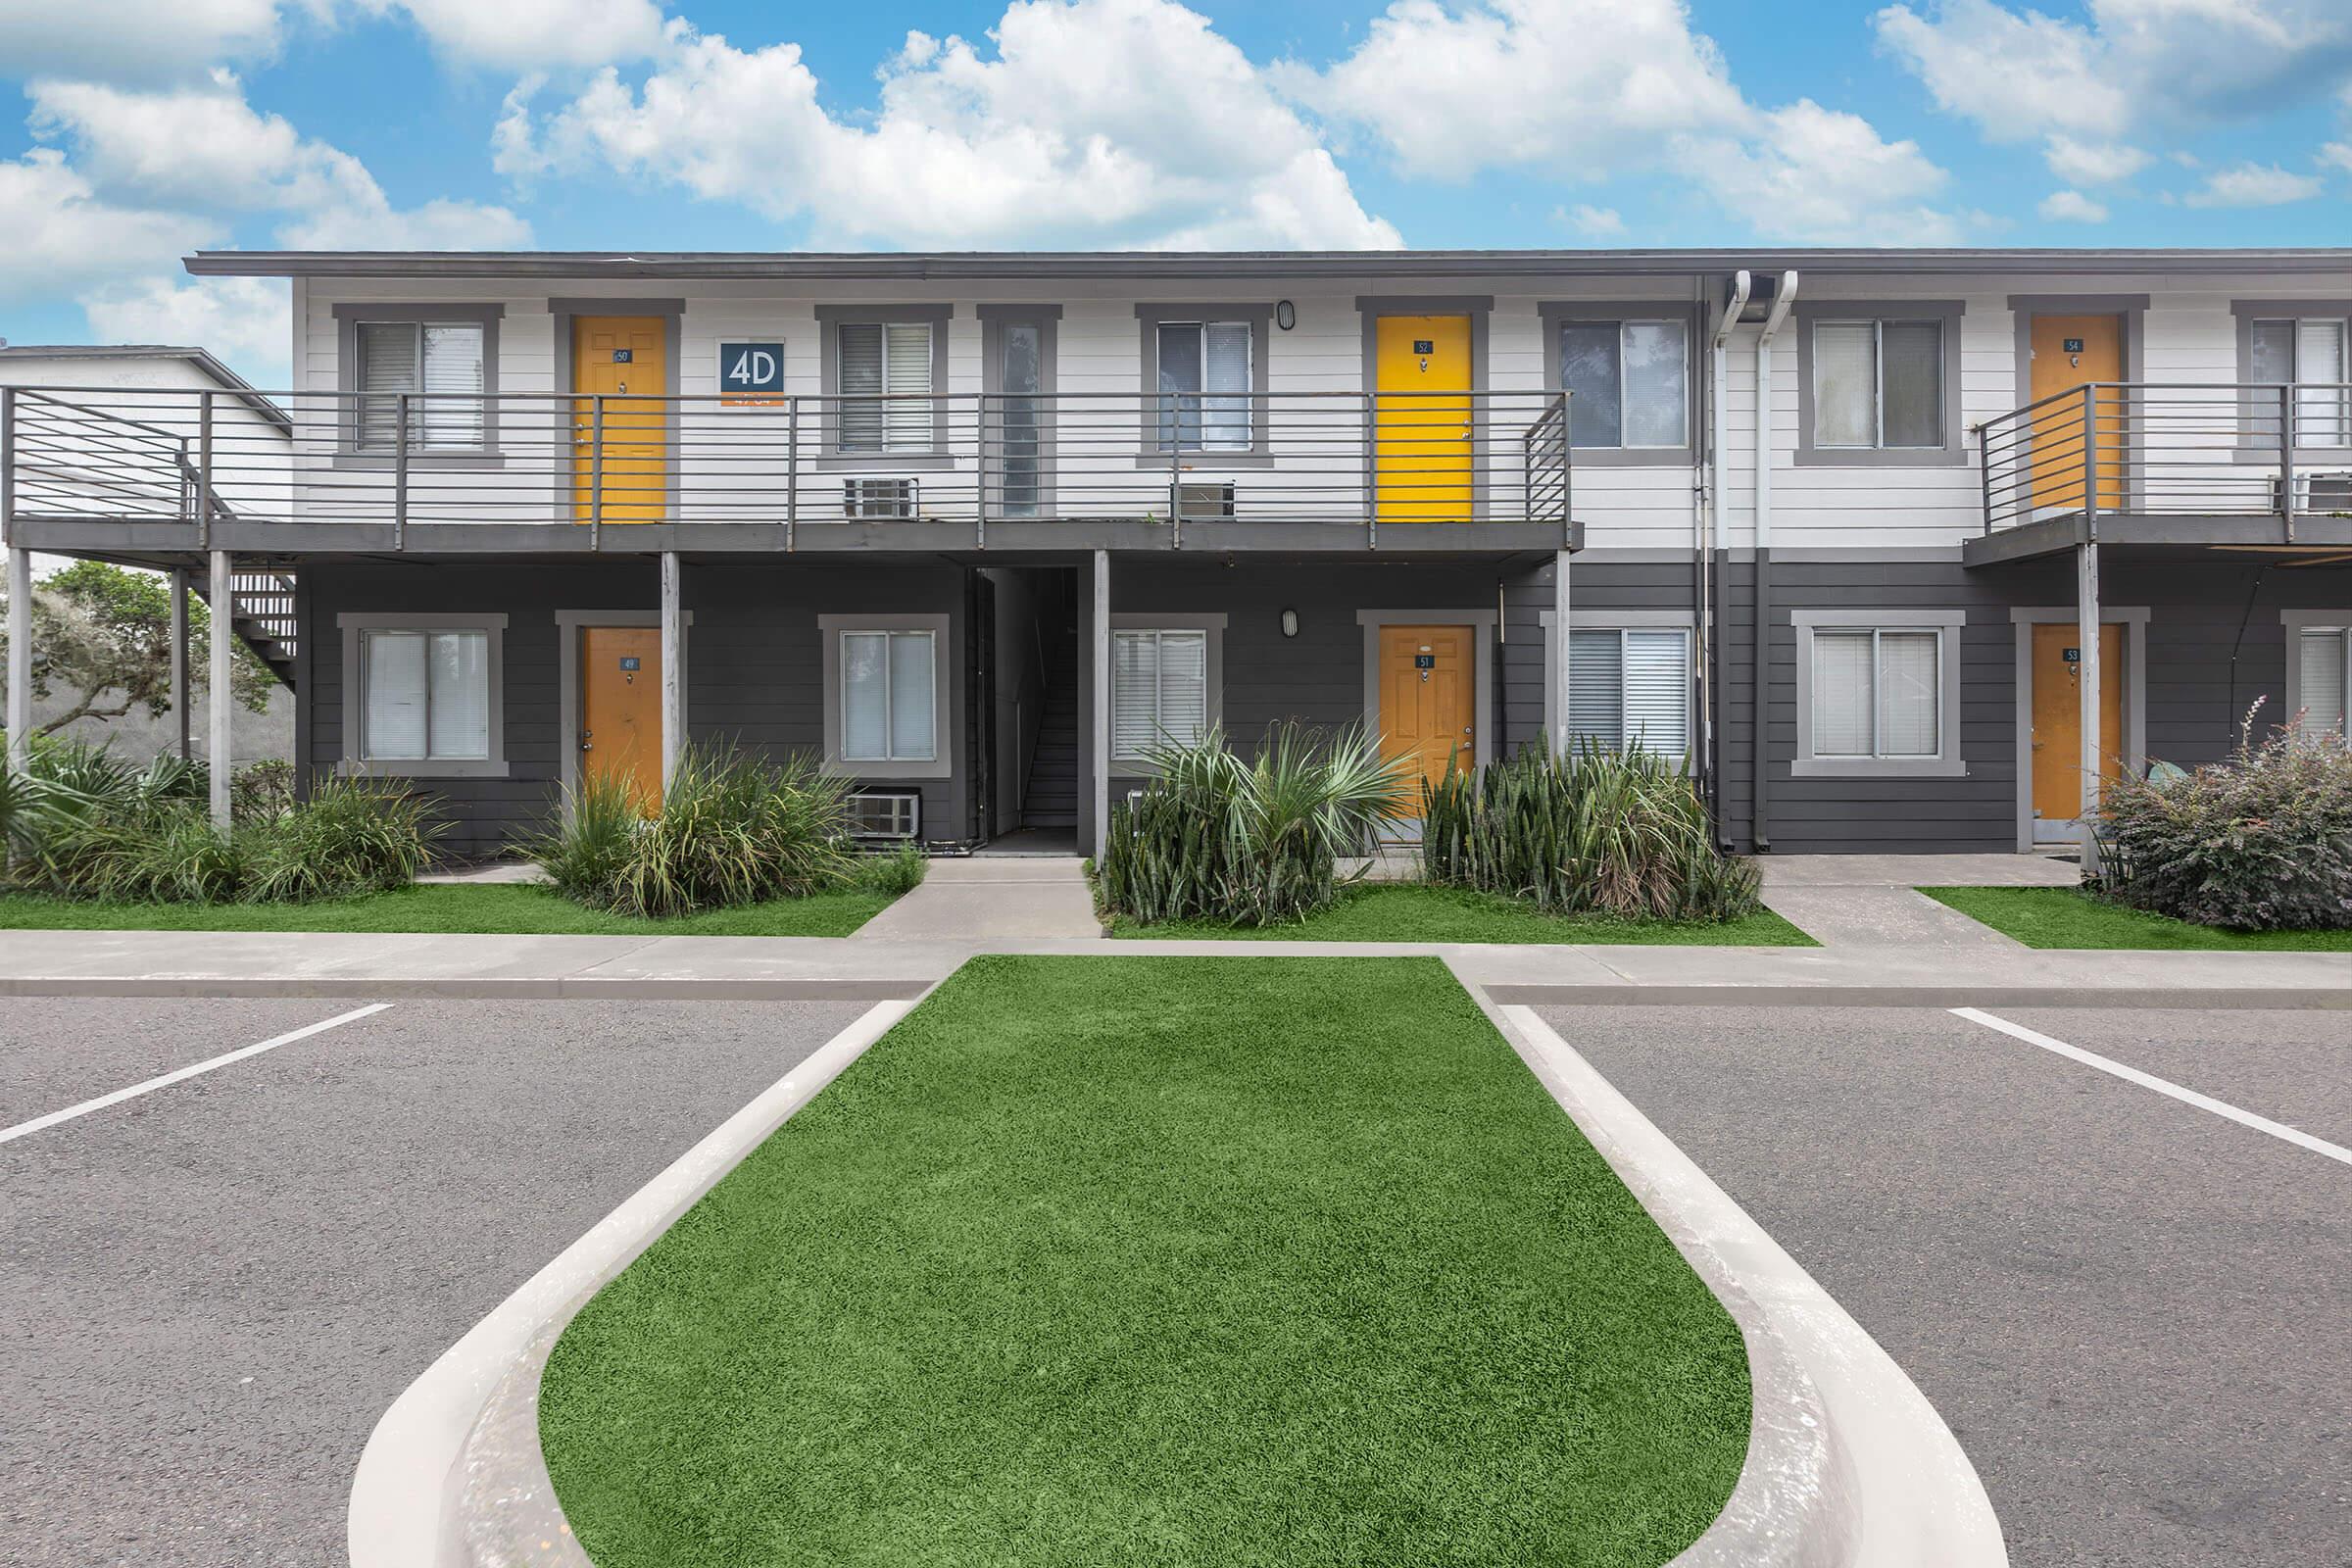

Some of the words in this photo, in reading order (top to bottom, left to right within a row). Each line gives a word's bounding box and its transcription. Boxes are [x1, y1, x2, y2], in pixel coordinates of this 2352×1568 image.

[2069, 340, 2079, 351] 54
[728, 349, 776, 385] 4D
[2068, 650, 2078, 661] 53
[1420, 657, 1429, 667] 51
